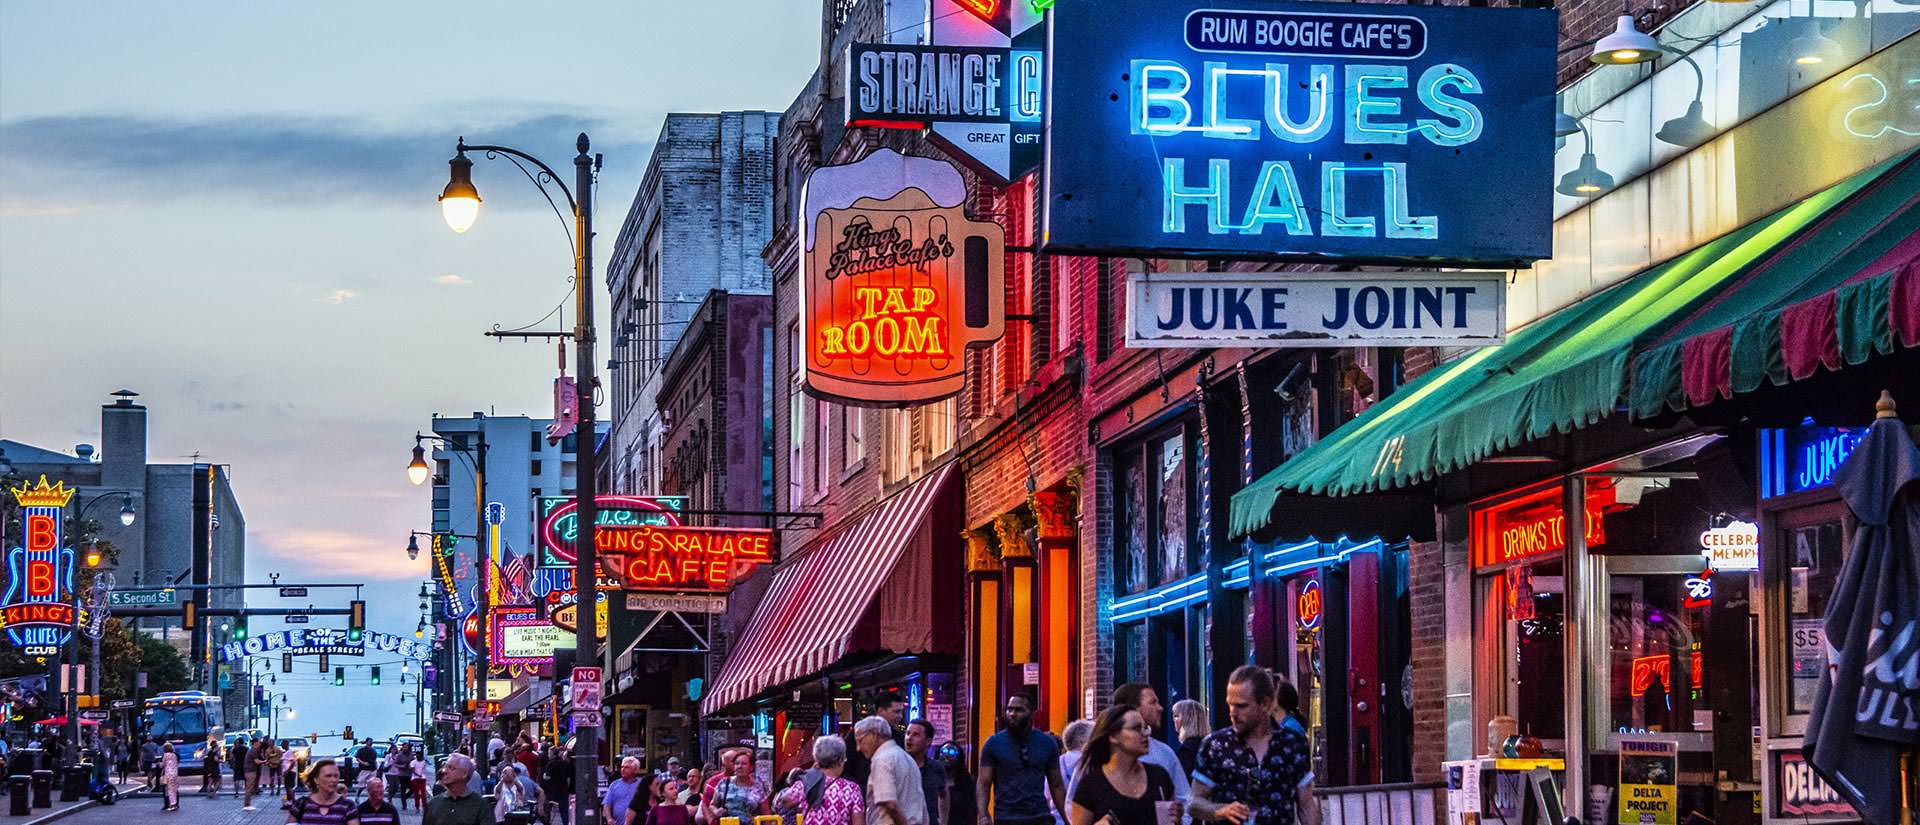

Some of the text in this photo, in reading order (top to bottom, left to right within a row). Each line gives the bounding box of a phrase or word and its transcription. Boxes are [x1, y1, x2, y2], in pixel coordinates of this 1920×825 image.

[1201, 17, 1412, 50] RUM BOOGIE CAFE'S
[859, 51, 1001, 116] STRANGE
[1130, 59, 1484, 147] BLUES
[967, 132, 1006, 143] GREAT
[1163, 158, 1438, 239] HALL
[837, 222, 901, 255] Kings
[857, 287, 936, 320] TAP
[1157, 286, 1476, 331] JUKE JOINT
[823, 316, 945, 354] ROOM
[595, 527, 664, 552] KING'S
[1503, 521, 1547, 558] DRINKS
[630, 560, 728, 582] CAFE
[124, 592, 157, 604] Second
[159, 592, 170, 602] St
[6, 605, 73, 624] KING'S
[25, 627, 58, 645] BLUES
[223, 629, 305, 662] HOME
[312, 636, 336, 645] THE
[346, 629, 432, 661] LUES
[1794, 629, 1820, 648] $5
[579, 670, 596, 680] NO
[1621, 741, 1674, 753] TONIGHT
[1627, 800, 1668, 811] PROJECT
[1633, 788, 1662, 798] DELTA
